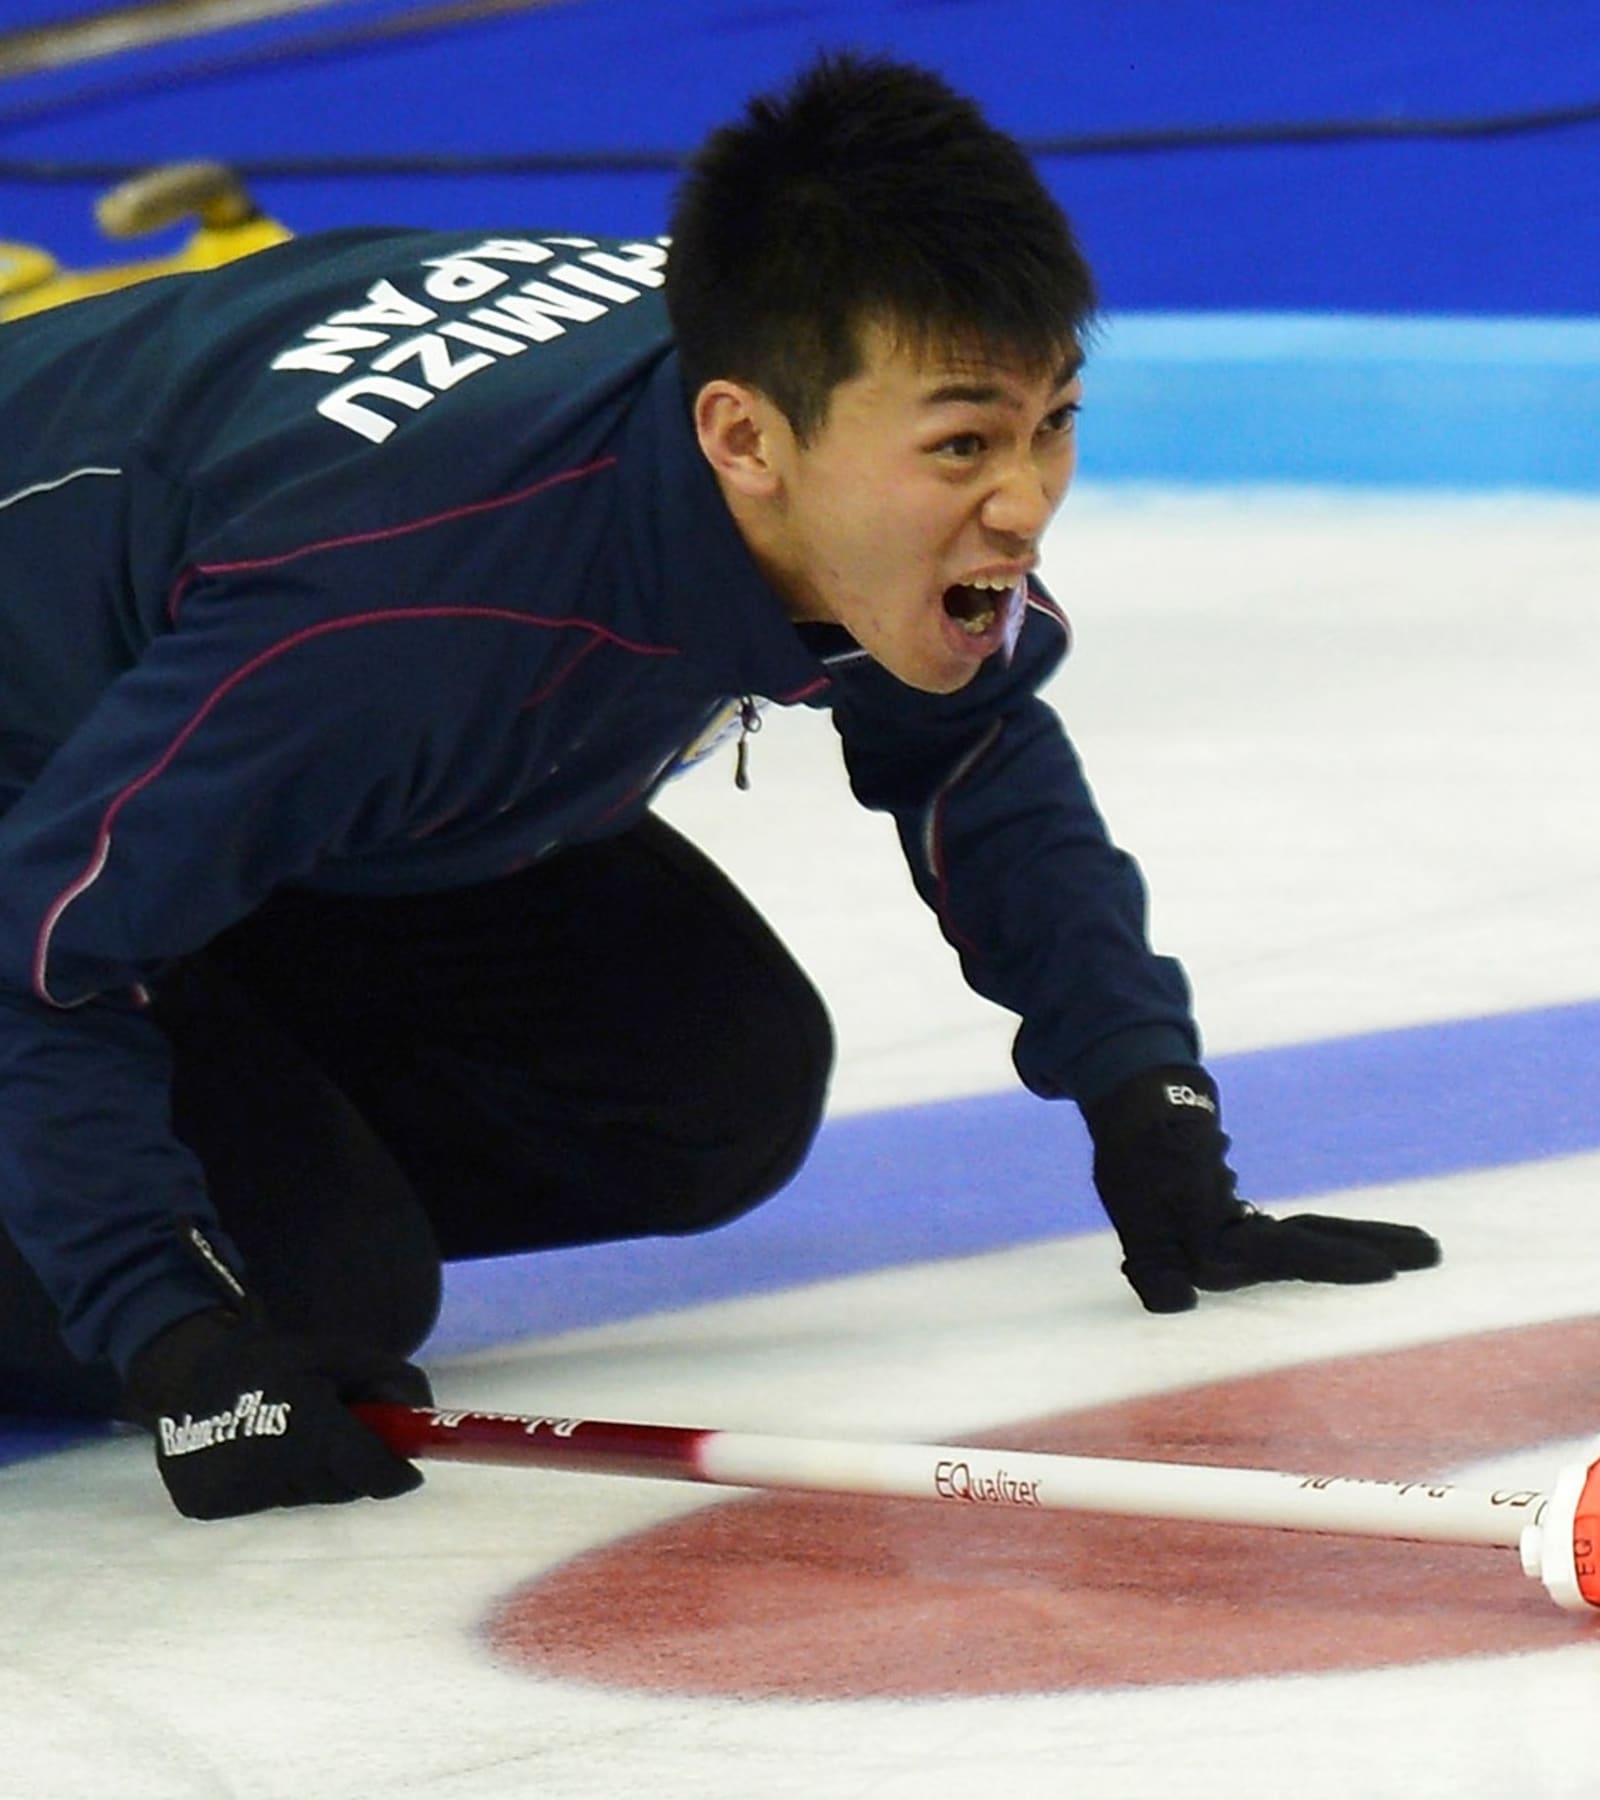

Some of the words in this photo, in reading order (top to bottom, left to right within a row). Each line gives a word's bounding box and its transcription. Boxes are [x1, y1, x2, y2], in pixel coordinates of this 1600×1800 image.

[271, 237, 599, 374] APAN
[317, 236, 673, 444] HIMIZU
[935, 1461, 1042, 1506] EQualizer
